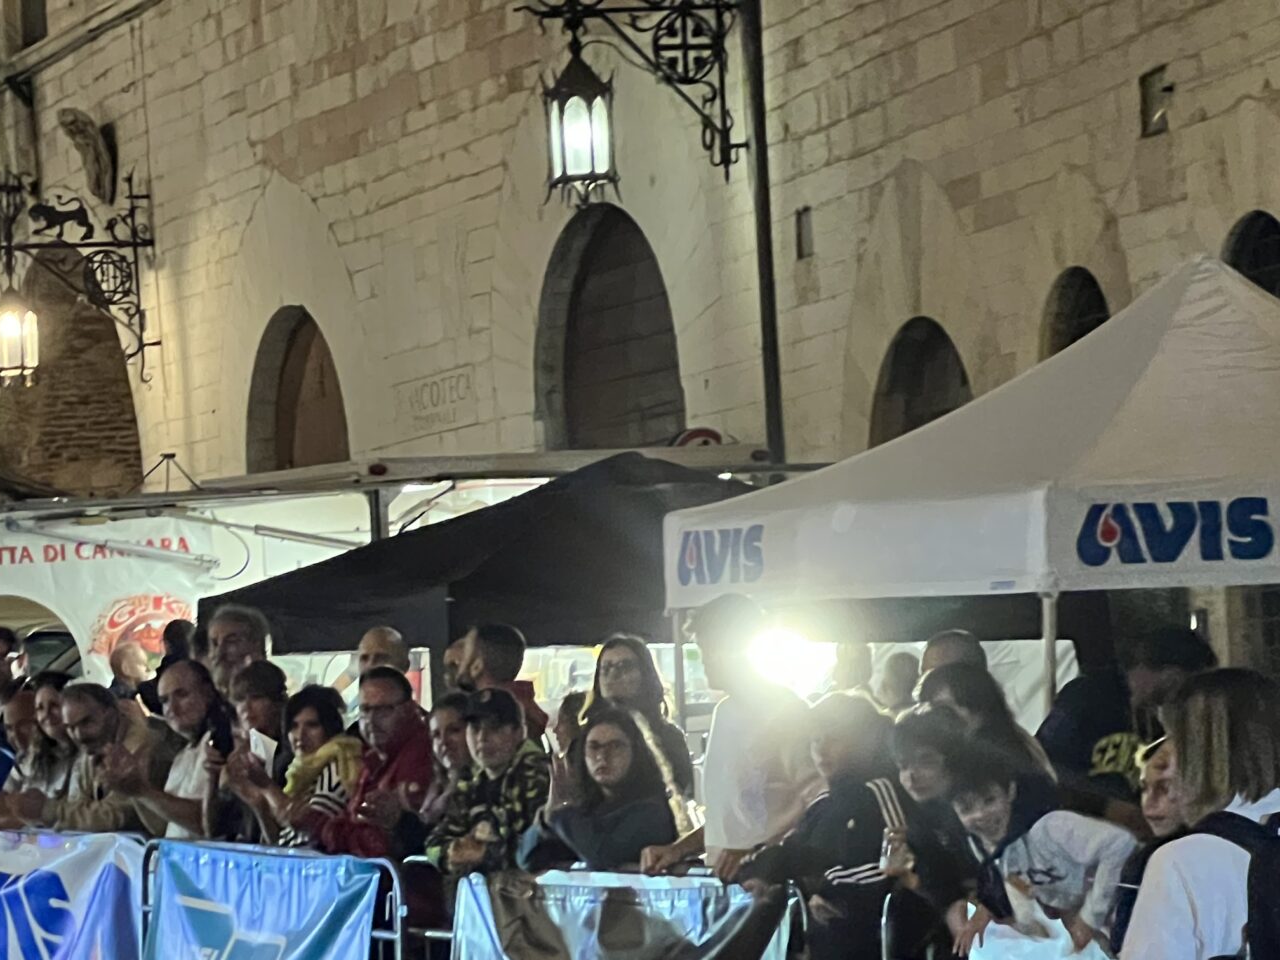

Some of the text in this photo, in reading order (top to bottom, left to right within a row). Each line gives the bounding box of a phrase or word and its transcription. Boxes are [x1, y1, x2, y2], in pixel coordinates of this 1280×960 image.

[43, 544, 66, 563] DI
[677, 525, 764, 586] AVIS
[1077, 497, 1275, 566] AVIS
